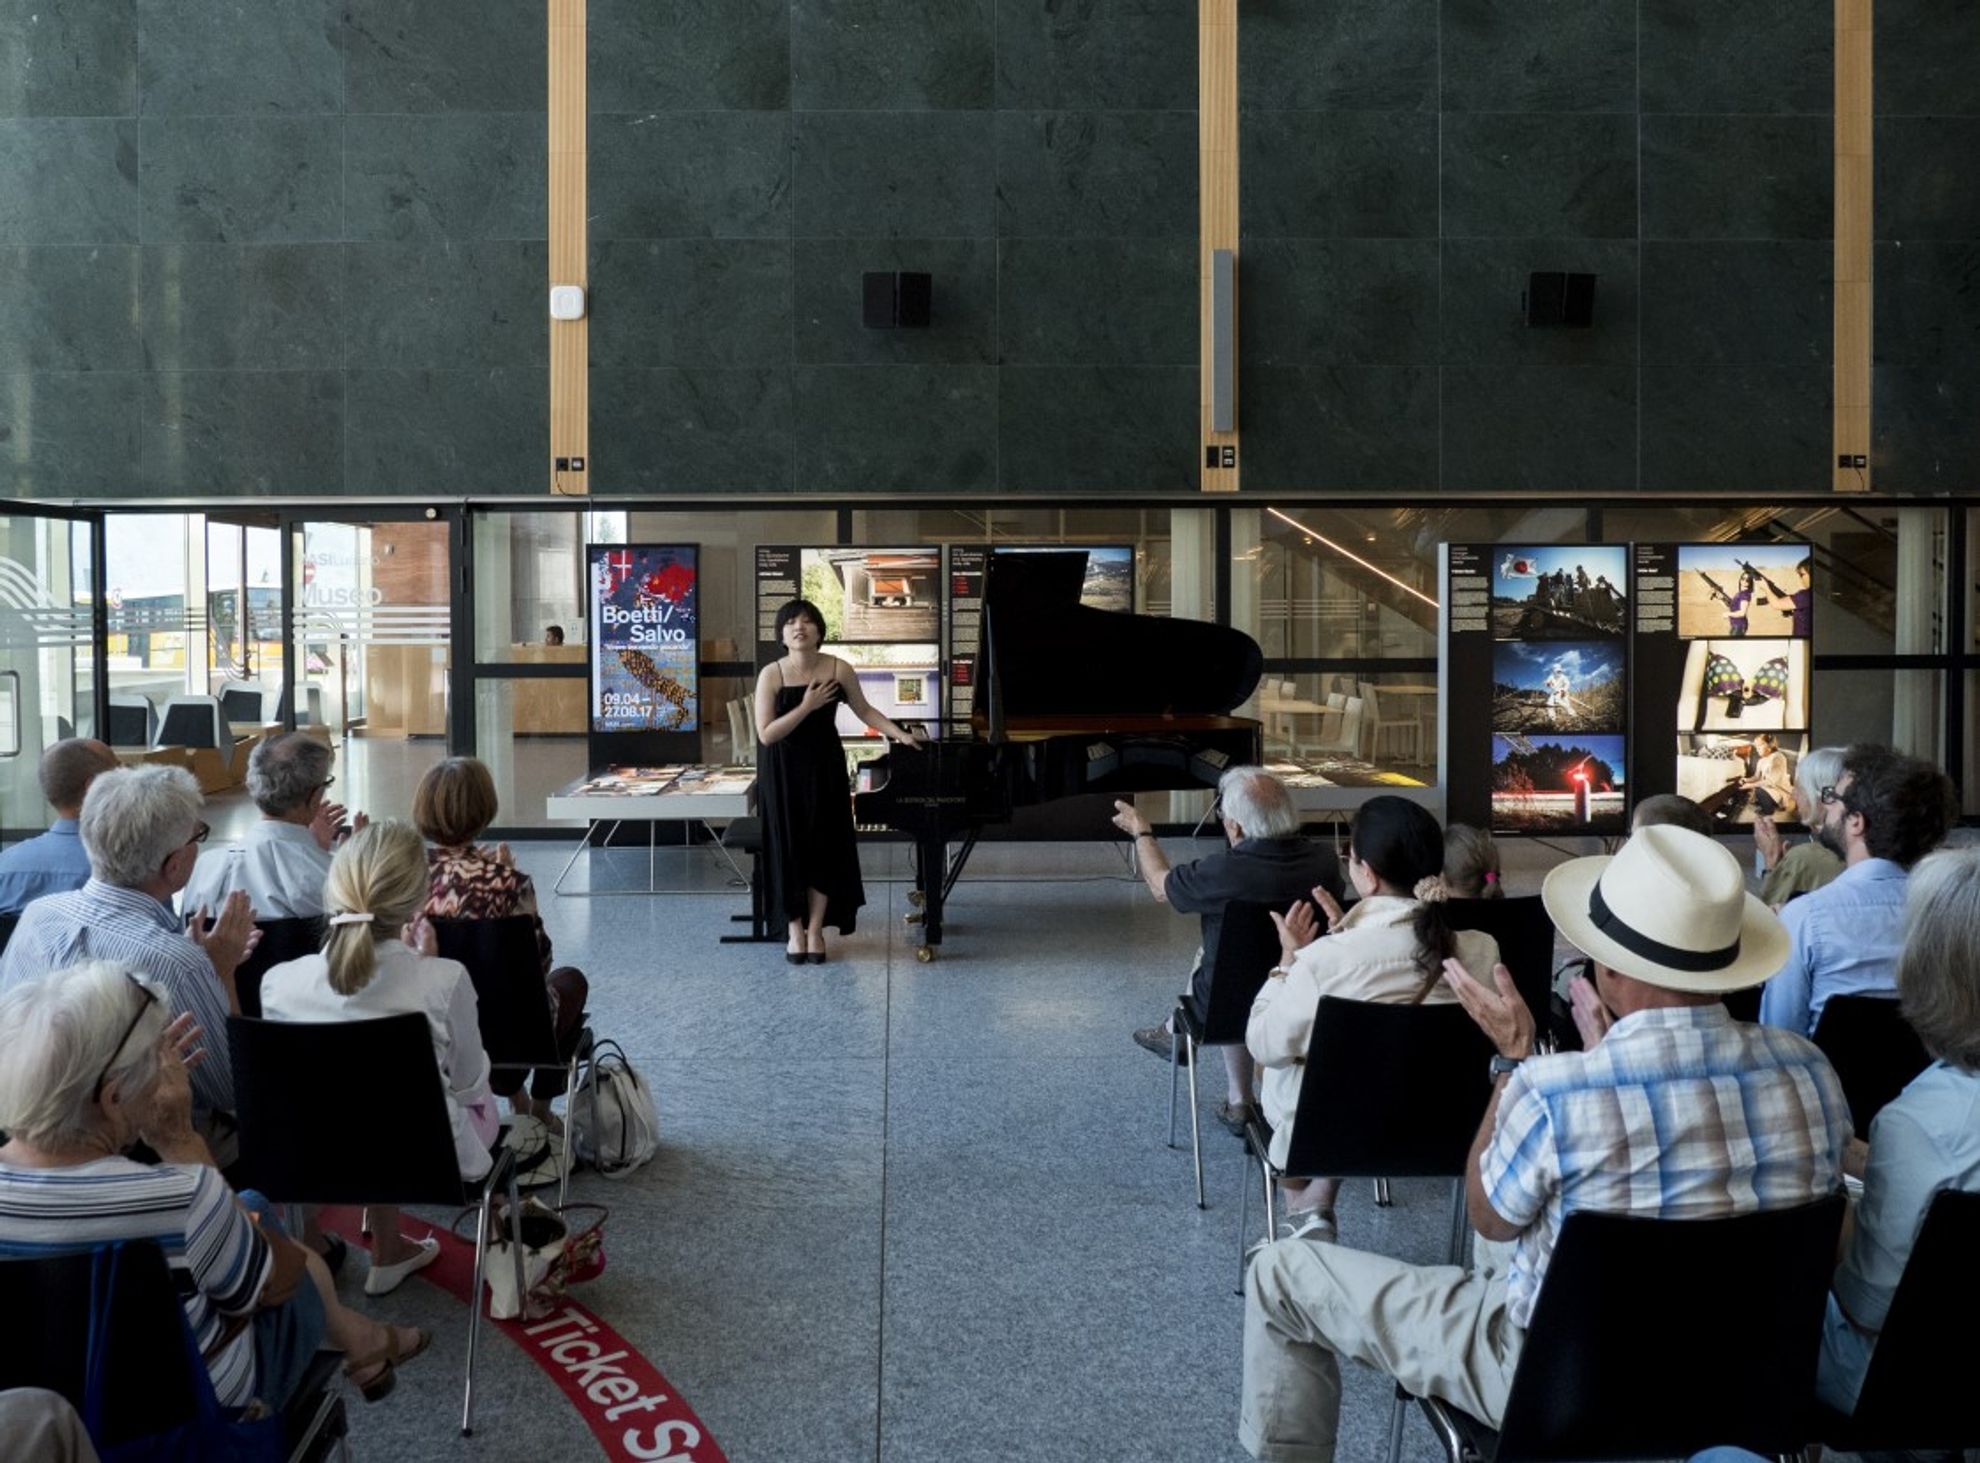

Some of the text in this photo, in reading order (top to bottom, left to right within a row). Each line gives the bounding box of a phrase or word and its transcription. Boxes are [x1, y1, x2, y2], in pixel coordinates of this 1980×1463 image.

[301, 583, 381, 606] Museo
[603, 605, 674, 624] Boetti/
[630, 624, 686, 642] Salvo
[604, 693, 640, 705] 09.04
[524, 1306, 702, 1463] Ticket S
